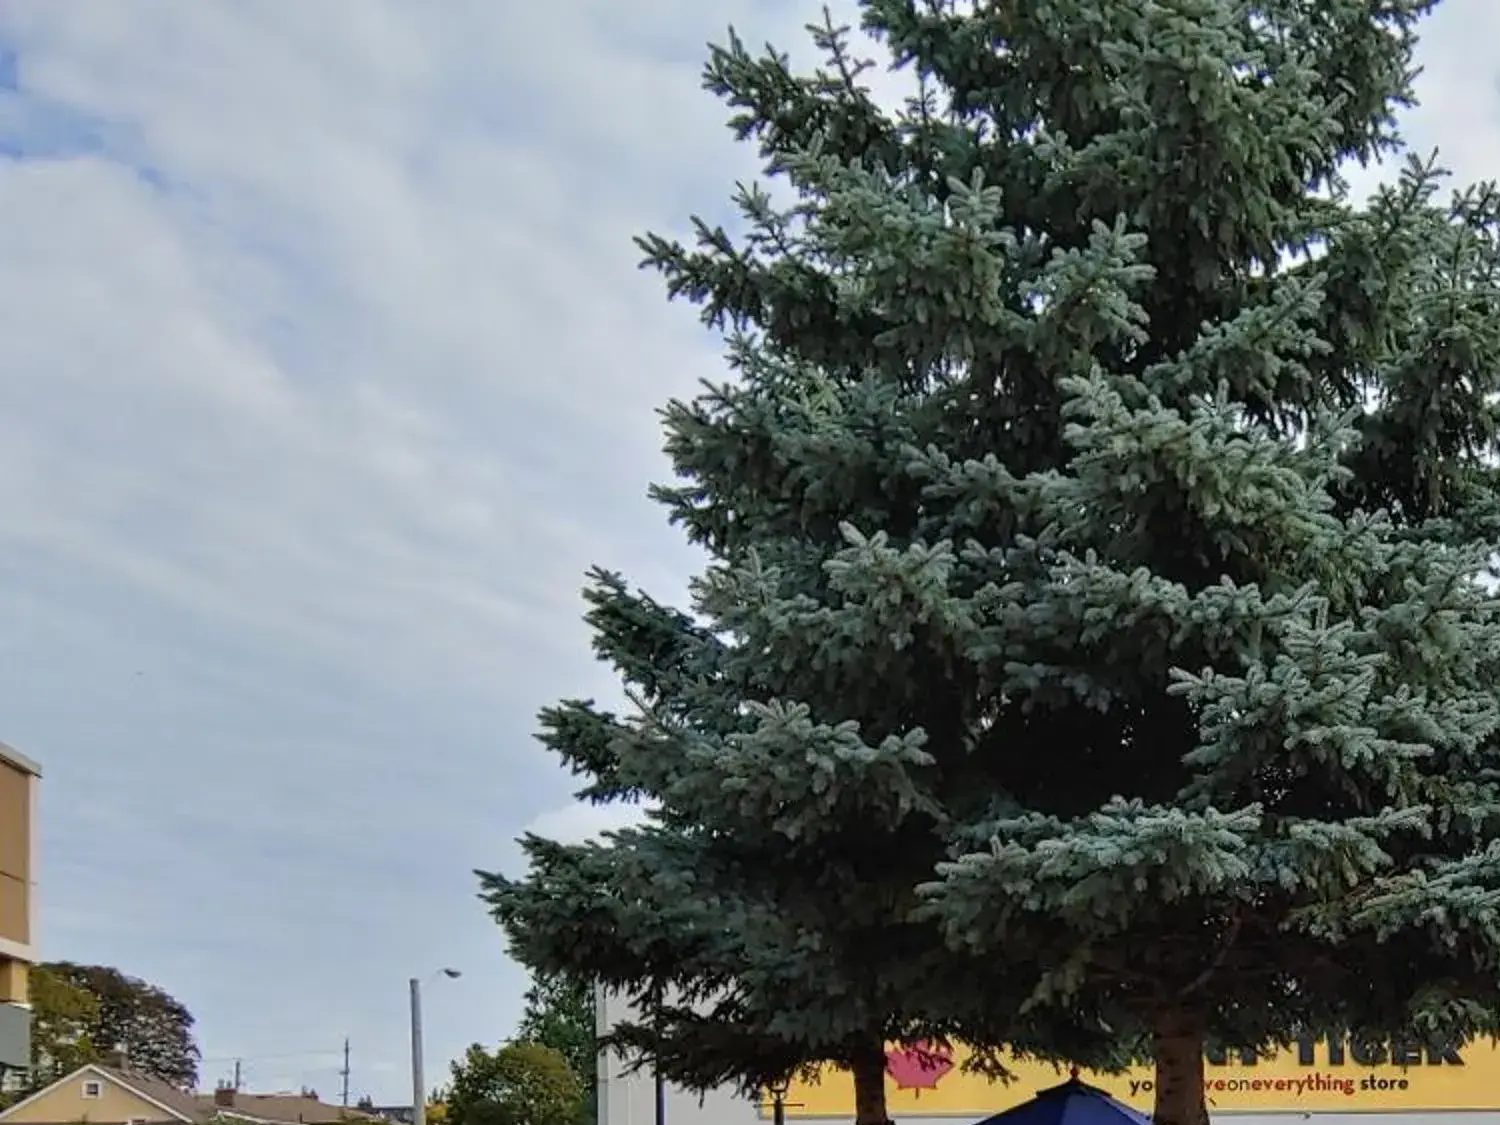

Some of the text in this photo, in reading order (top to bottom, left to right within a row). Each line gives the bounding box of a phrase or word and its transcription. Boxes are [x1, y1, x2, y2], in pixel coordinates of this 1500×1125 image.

[1129, 1072, 1409, 1096] yo veoneverything store
